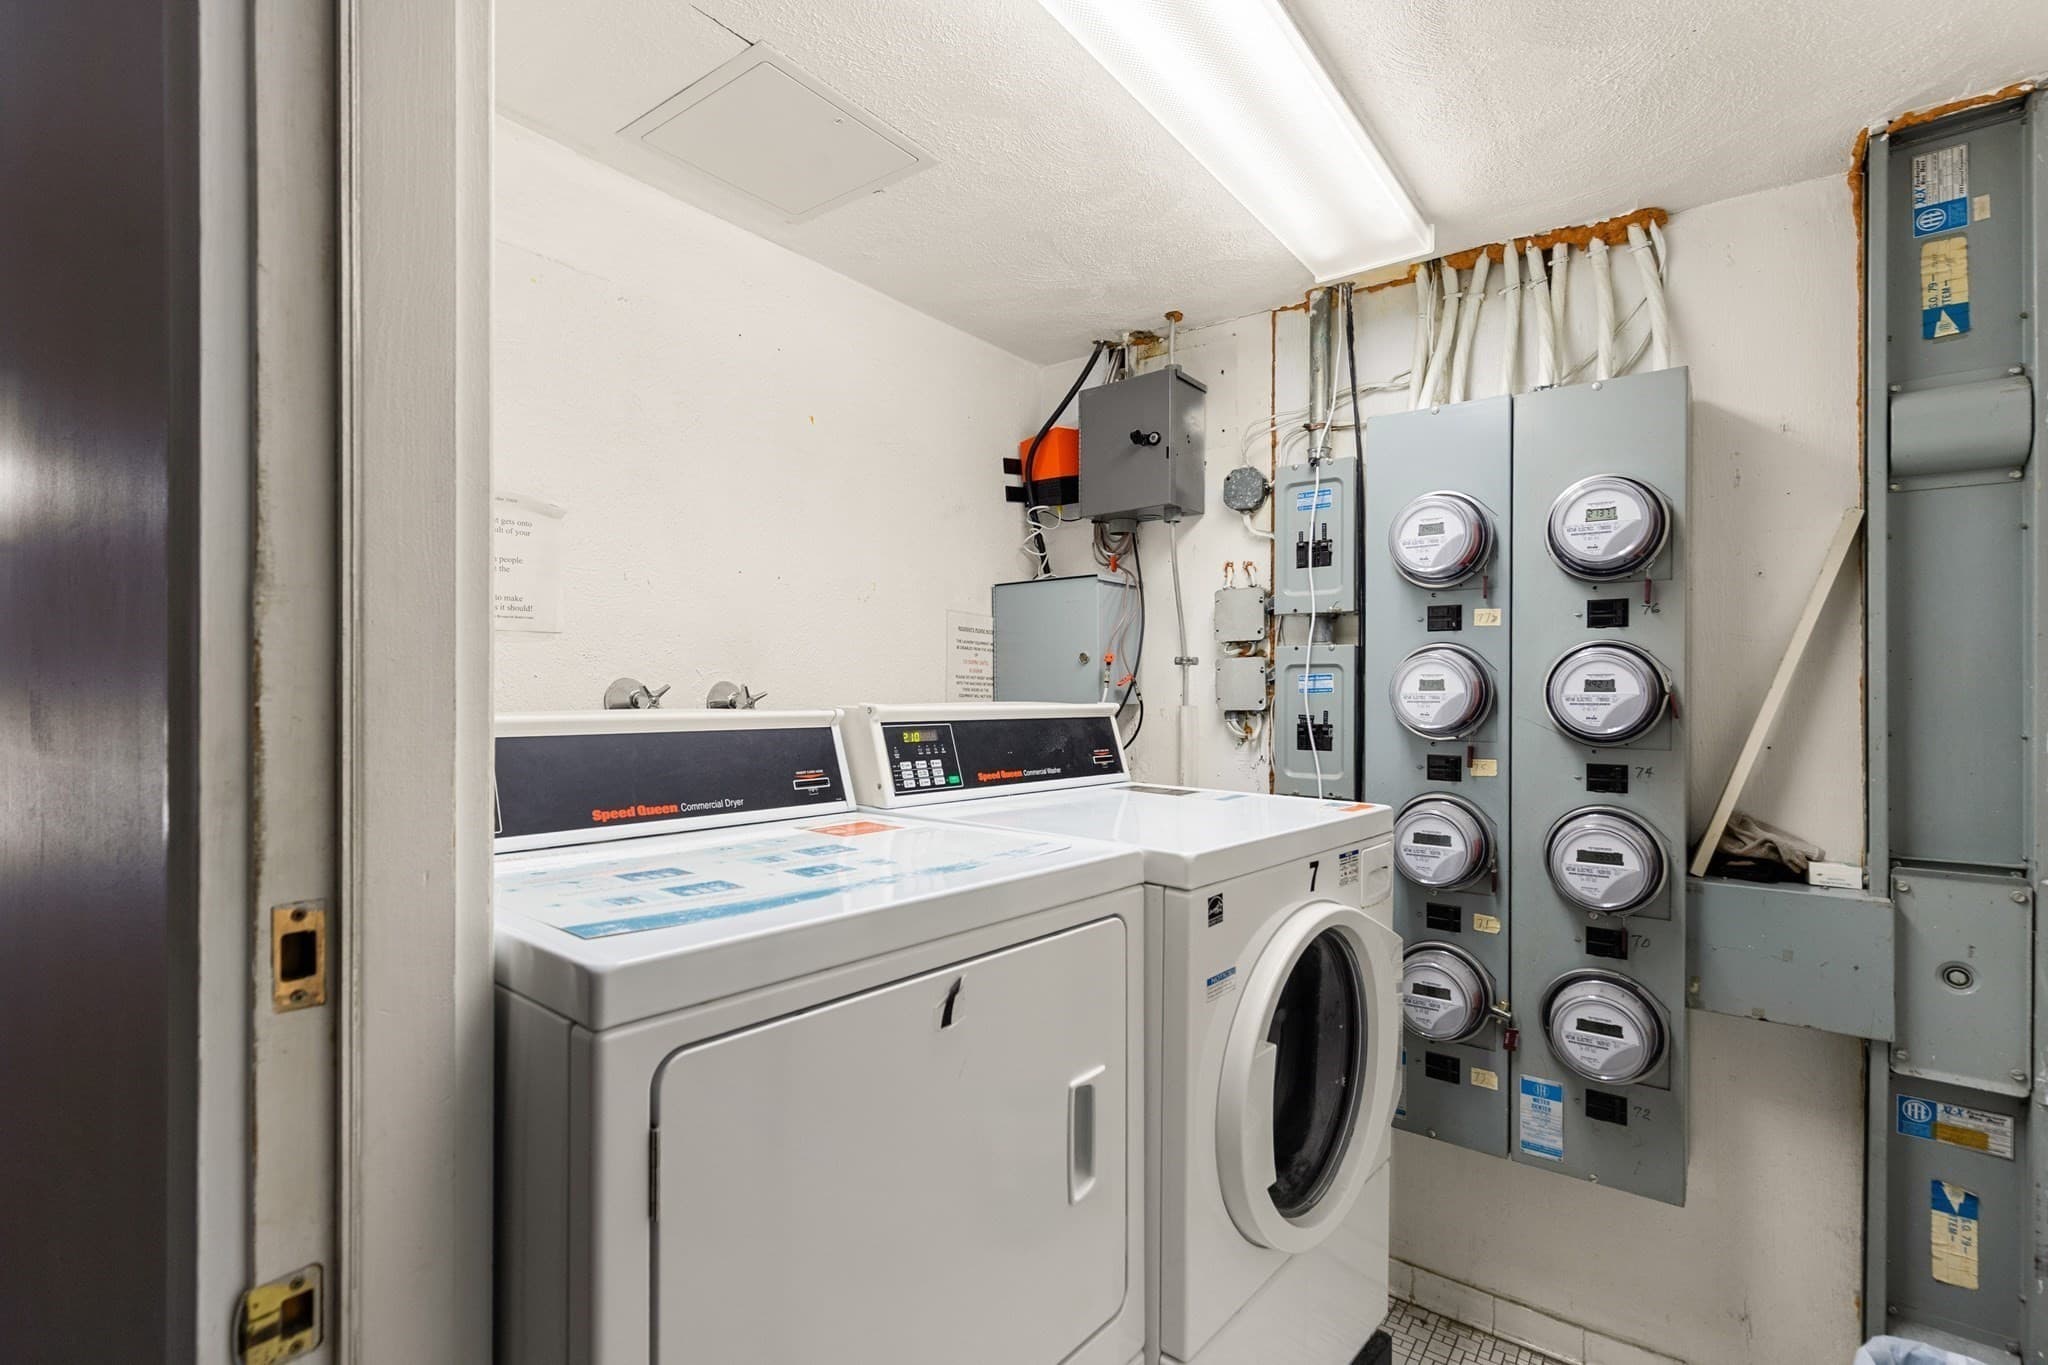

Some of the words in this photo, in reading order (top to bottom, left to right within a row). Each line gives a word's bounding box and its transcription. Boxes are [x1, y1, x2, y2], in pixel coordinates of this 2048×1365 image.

[499, 556, 523, 565] people
[499, 565, 510, 573] the
[504, 594, 523, 602] make
[507, 604, 533, 613] should!
[1640, 602, 1661, 616] 76
[977, 770, 1000, 782] Speed
[1000, 770, 1023, 779] Queen
[1023, 769, 1047, 777] Commercial
[1634, 765, 1656, 779] 74
[592, 809, 635, 822] Speed
[637, 804, 678, 816] Queen
[680, 799, 723, 812] Commercial
[724, 798, 744, 808] Dryer
[1310, 860, 1319, 892] 7
[1632, 1106, 1652, 1121] 72
